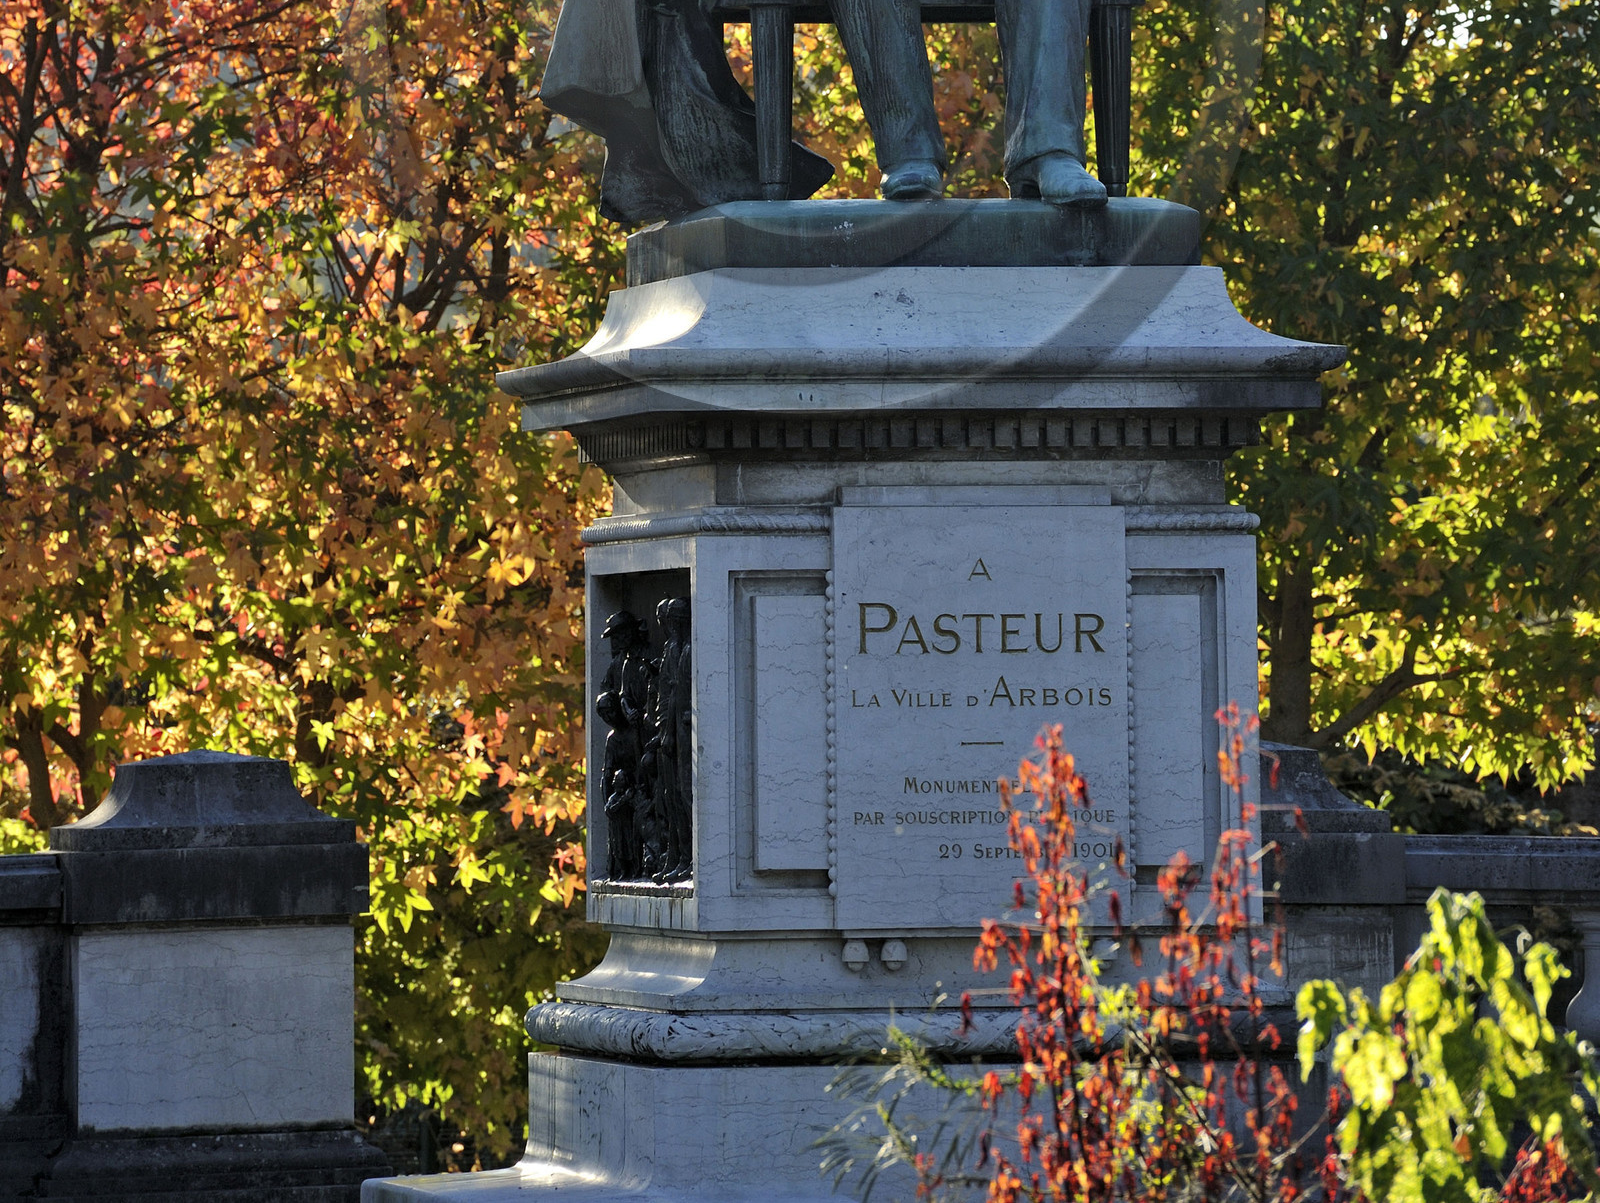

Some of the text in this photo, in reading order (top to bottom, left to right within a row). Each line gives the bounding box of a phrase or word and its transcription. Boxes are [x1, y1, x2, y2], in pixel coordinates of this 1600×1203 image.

[967, 557, 993, 582] A
[857, 602, 1106, 655] PASTEUR
[851, 675, 1112, 708] LA VILLE D'ARBOIS
[903, 776, 1003, 794] MONUMENT
[853, 811, 886, 825] PAR
[938, 843, 963, 860] 29
[1072, 841, 1114, 858] 1901
